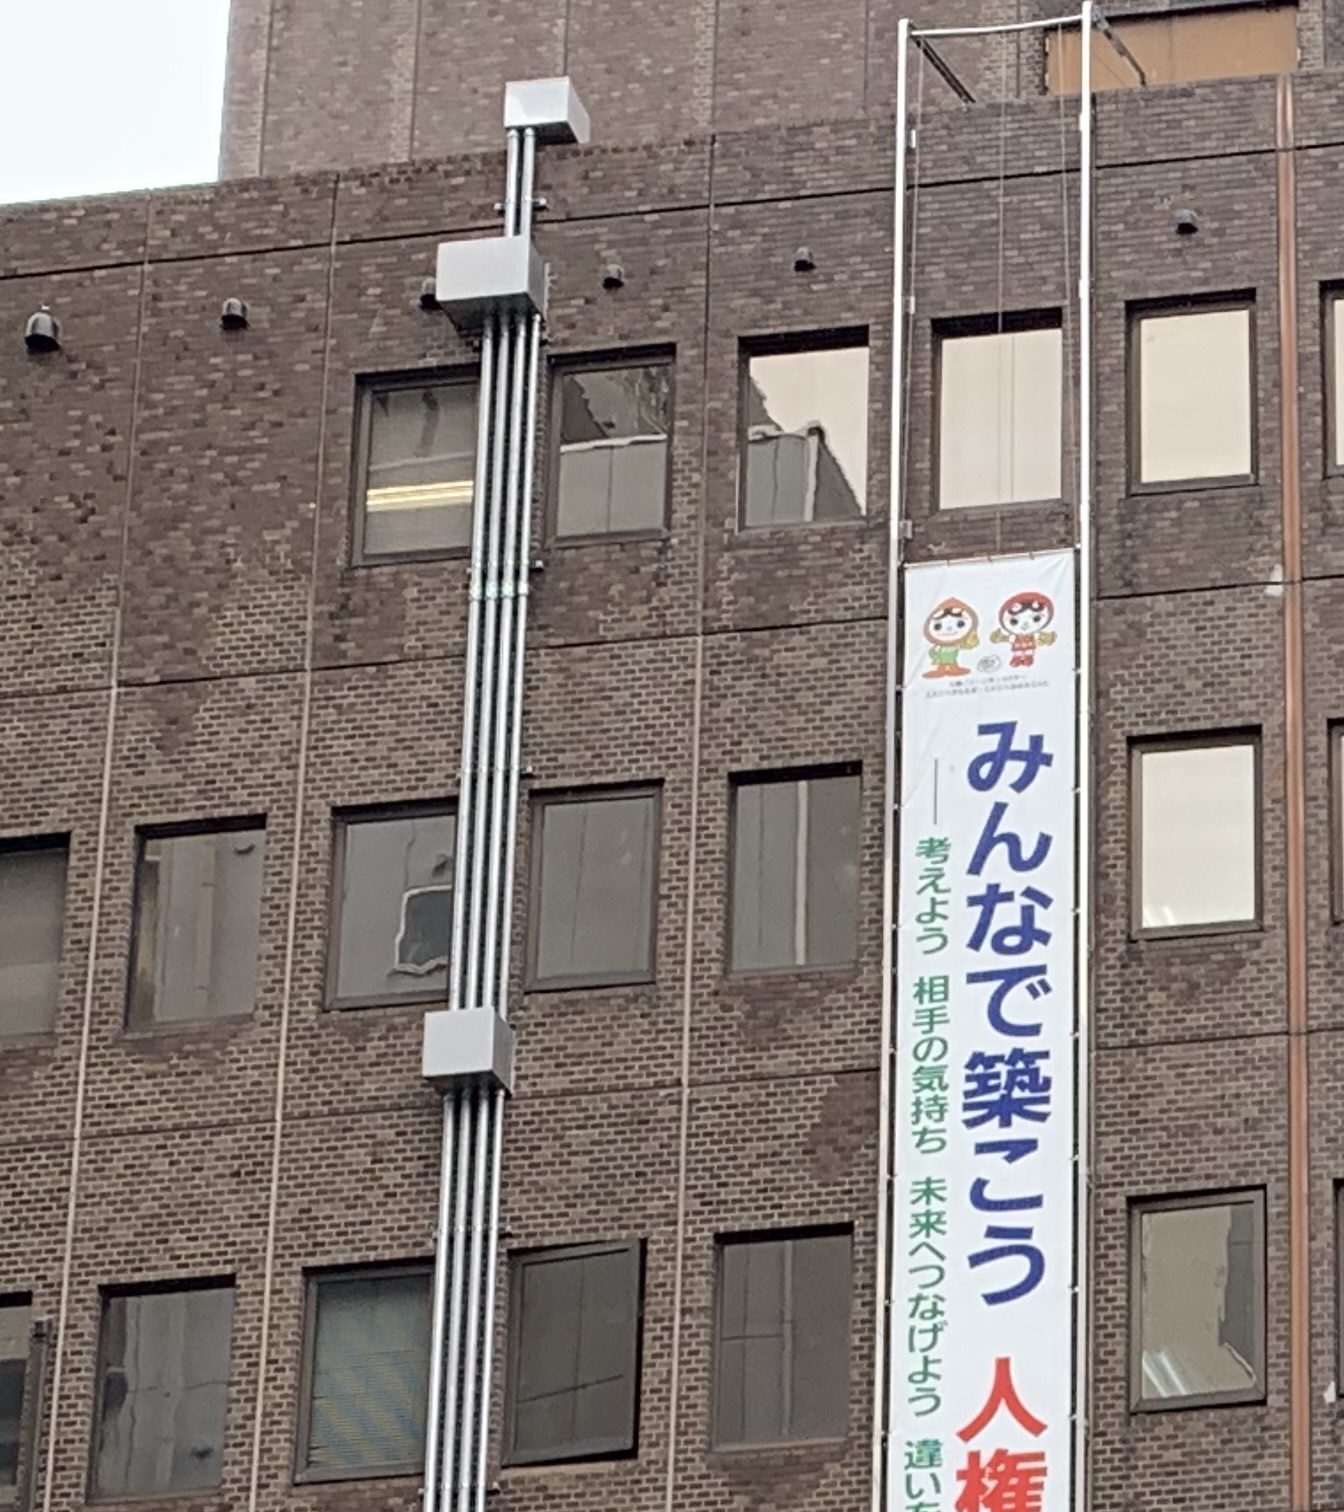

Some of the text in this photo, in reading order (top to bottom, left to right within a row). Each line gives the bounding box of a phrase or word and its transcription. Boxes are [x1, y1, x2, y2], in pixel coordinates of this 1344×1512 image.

[914, 836, 951, 955] 考えよう
[911, 975, 950, 1154] 相手の気持ち
[961, 720, 1053, 1306] みんなで築こう
[907, 1177, 949, 1417] 未来へつなげよう
